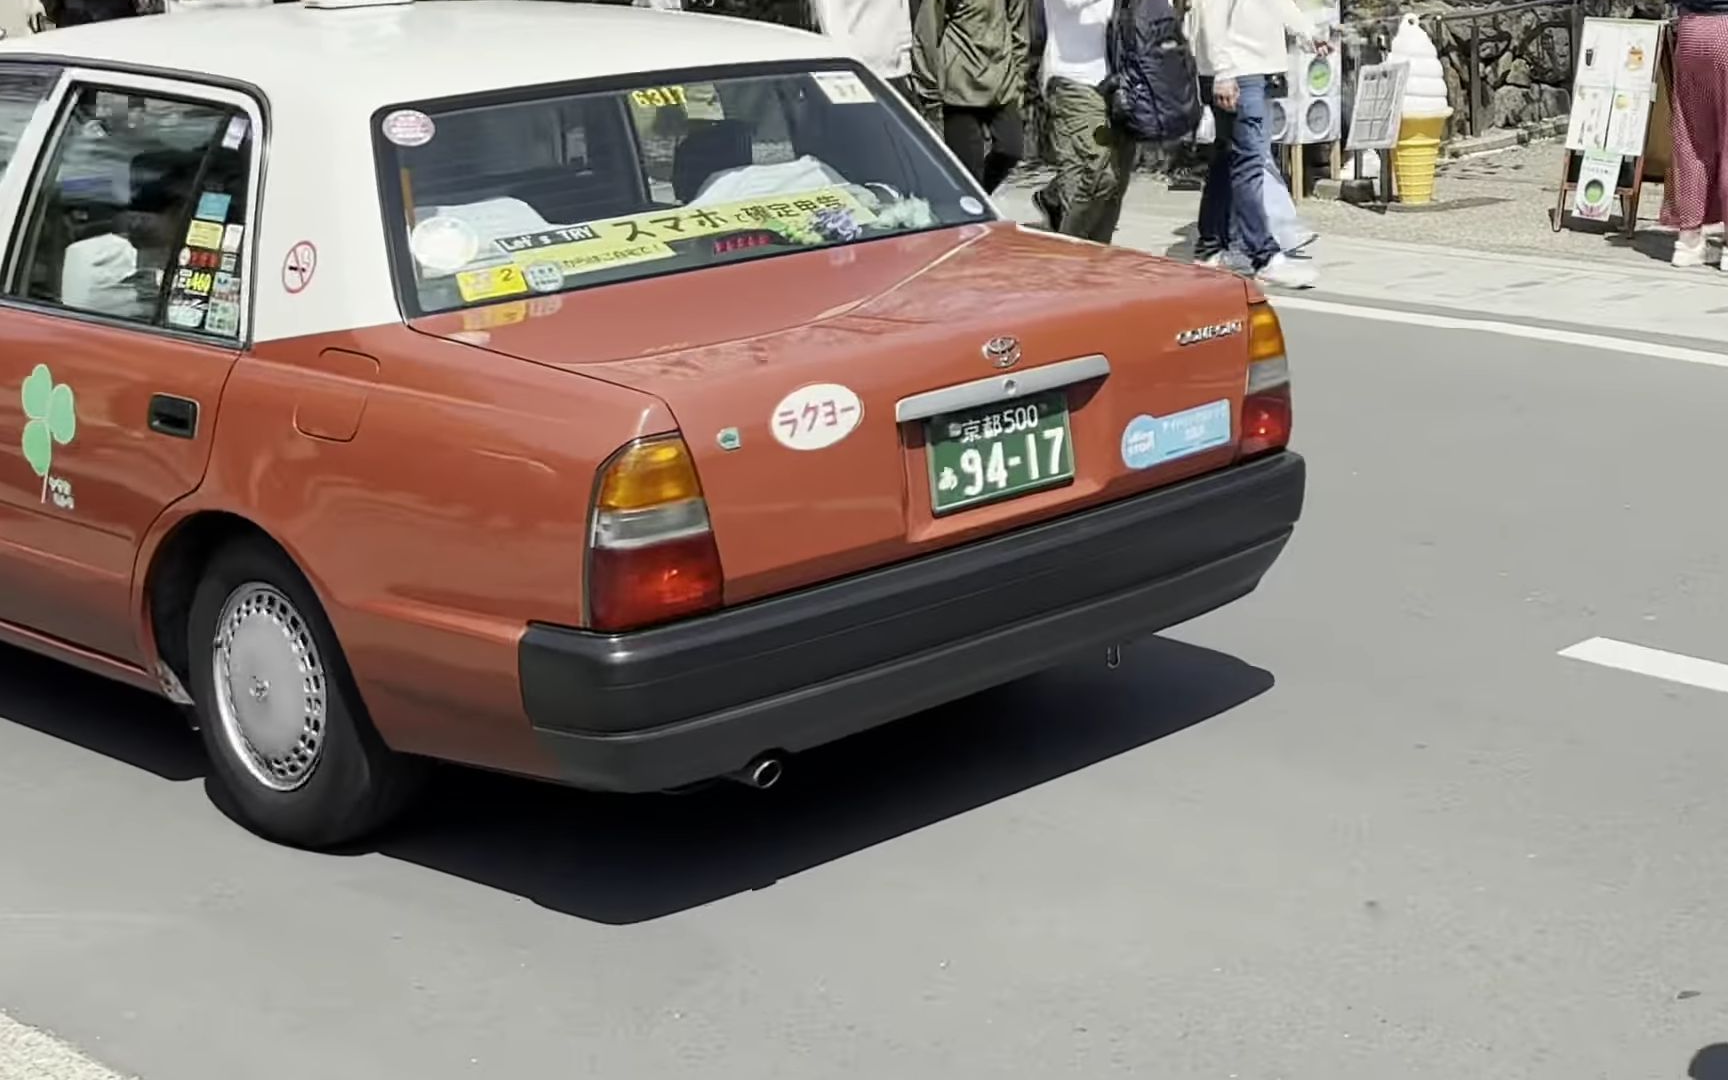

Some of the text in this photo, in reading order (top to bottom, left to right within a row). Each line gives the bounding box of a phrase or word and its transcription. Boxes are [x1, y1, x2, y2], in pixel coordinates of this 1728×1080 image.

[561, 224, 595, 242] TRY
[778, 399, 855, 438] ラクヨー
[960, 426, 1065, 496] 94-17
[938, 466, 959, 491] あ
